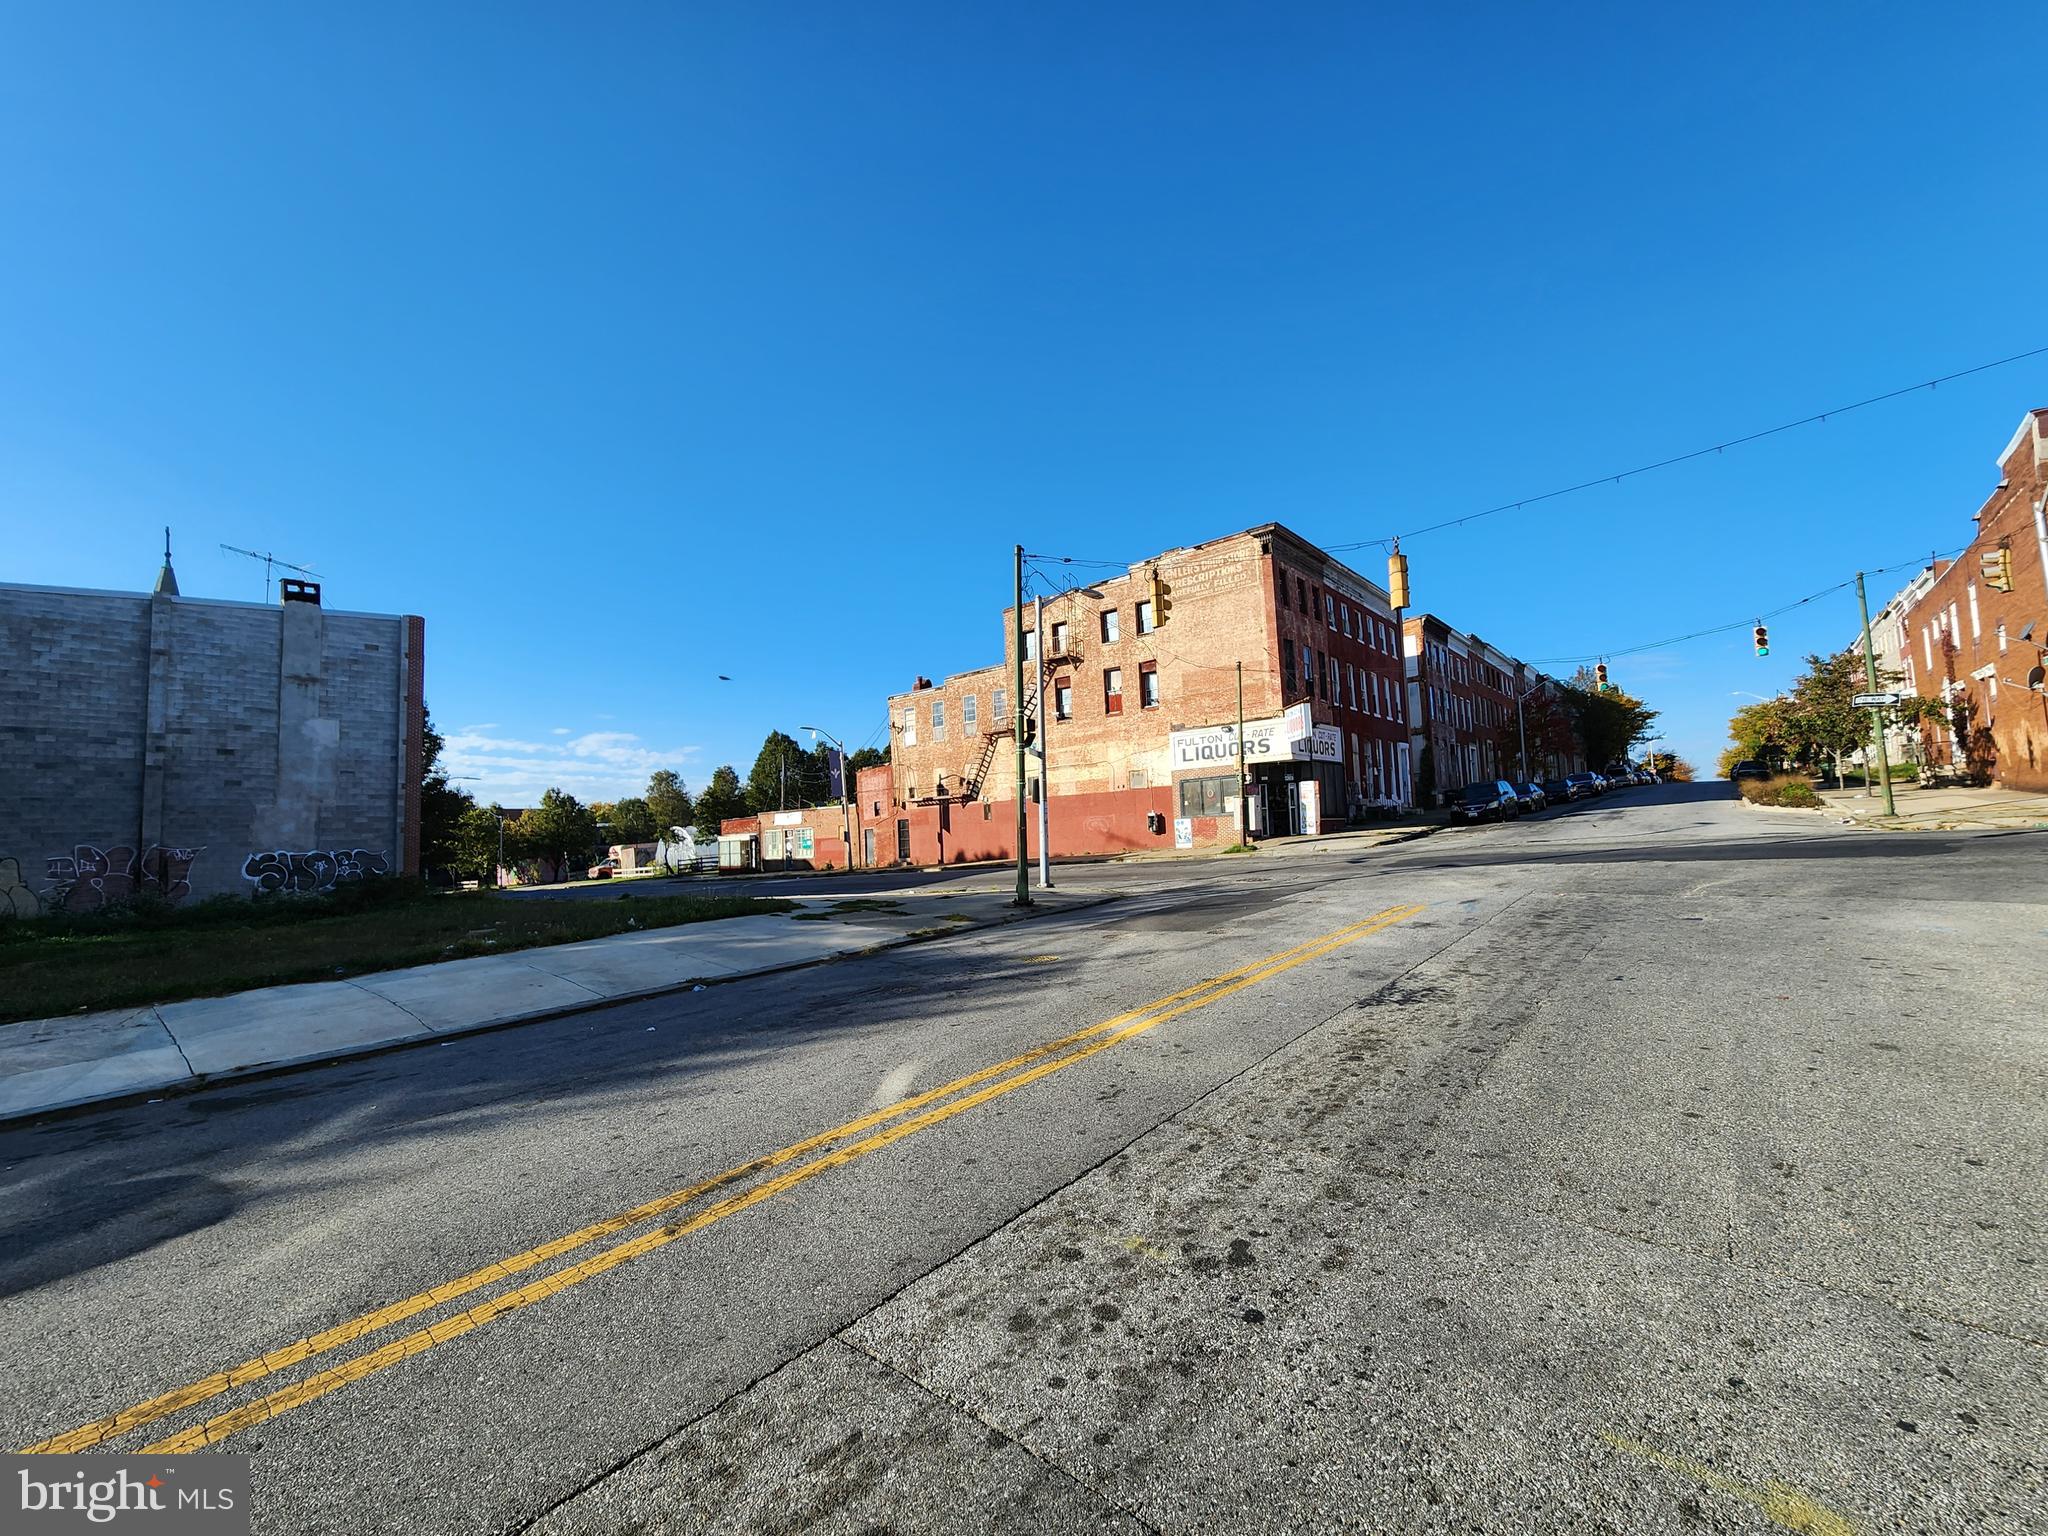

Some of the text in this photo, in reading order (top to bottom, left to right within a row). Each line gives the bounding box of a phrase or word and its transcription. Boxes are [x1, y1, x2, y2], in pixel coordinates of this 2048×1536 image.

[1170, 563, 1242, 588] PRESCRIPTIONS
[1170, 582, 1211, 598] AREFULLY
[1177, 734, 1223, 747] FULTON
[1298, 738, 1336, 756] LIQUORS
[1182, 738, 1271, 762] LIQUORS
